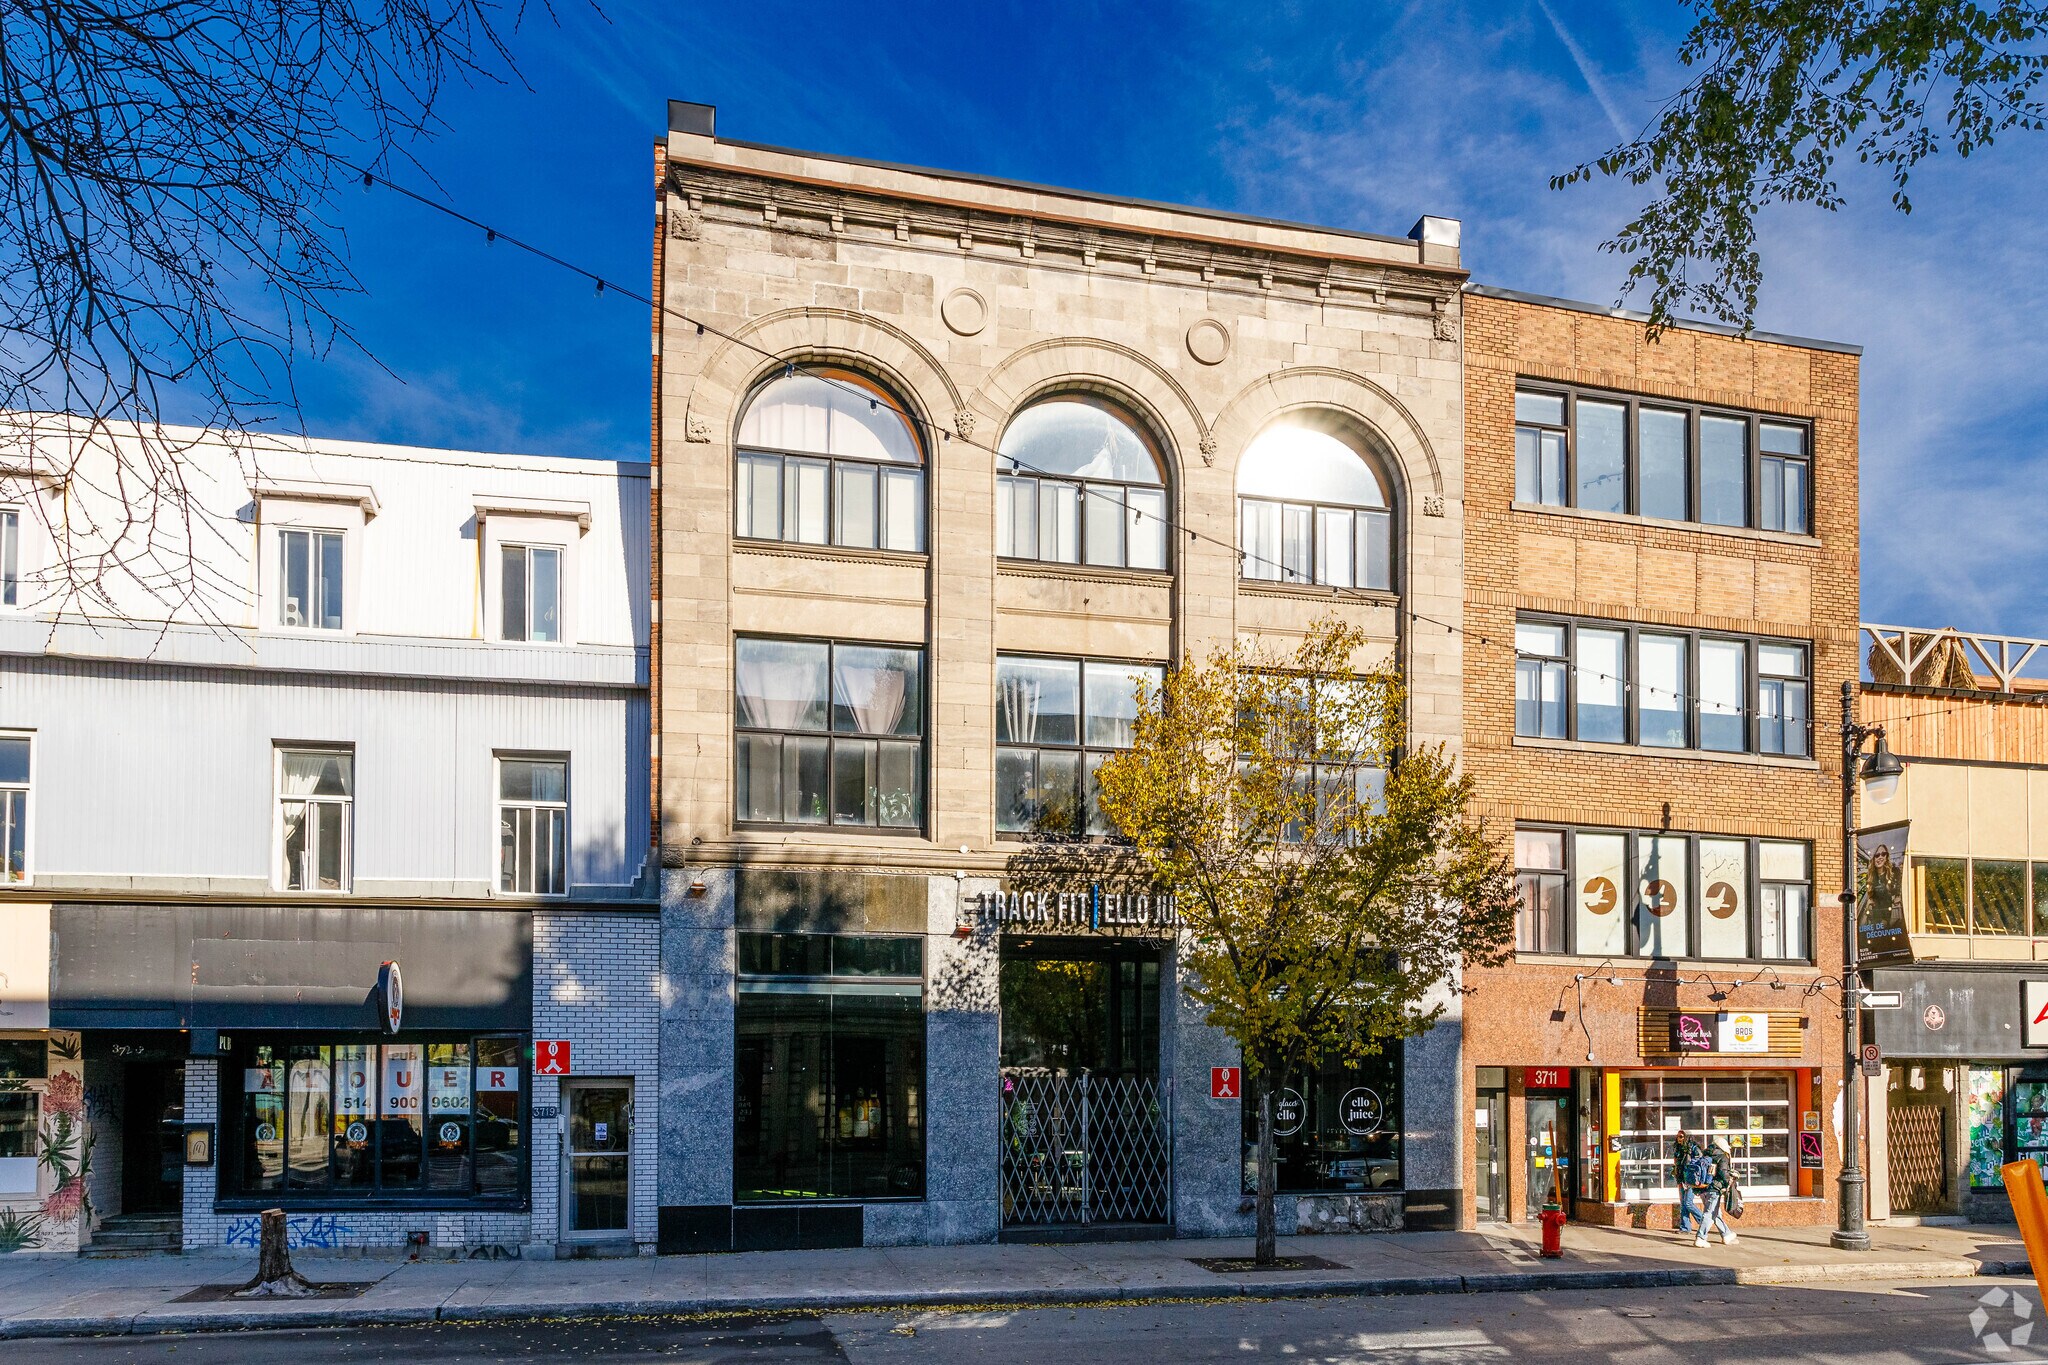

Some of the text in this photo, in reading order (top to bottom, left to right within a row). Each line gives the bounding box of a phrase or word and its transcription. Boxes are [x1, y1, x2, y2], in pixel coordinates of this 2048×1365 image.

[981, 890, 1049, 922] TRACK
[1058, 892, 1089, 923] FIT
[1104, 893, 1148, 924] ELLO
[1735, 1027, 1753, 1036] BROS
[1535, 1070, 1558, 1085] 3711
[343, 1096, 469, 1109] 514 900 9602
[533, 1107, 556, 1117] 3719
[1347, 1108, 1374, 1122] juice
